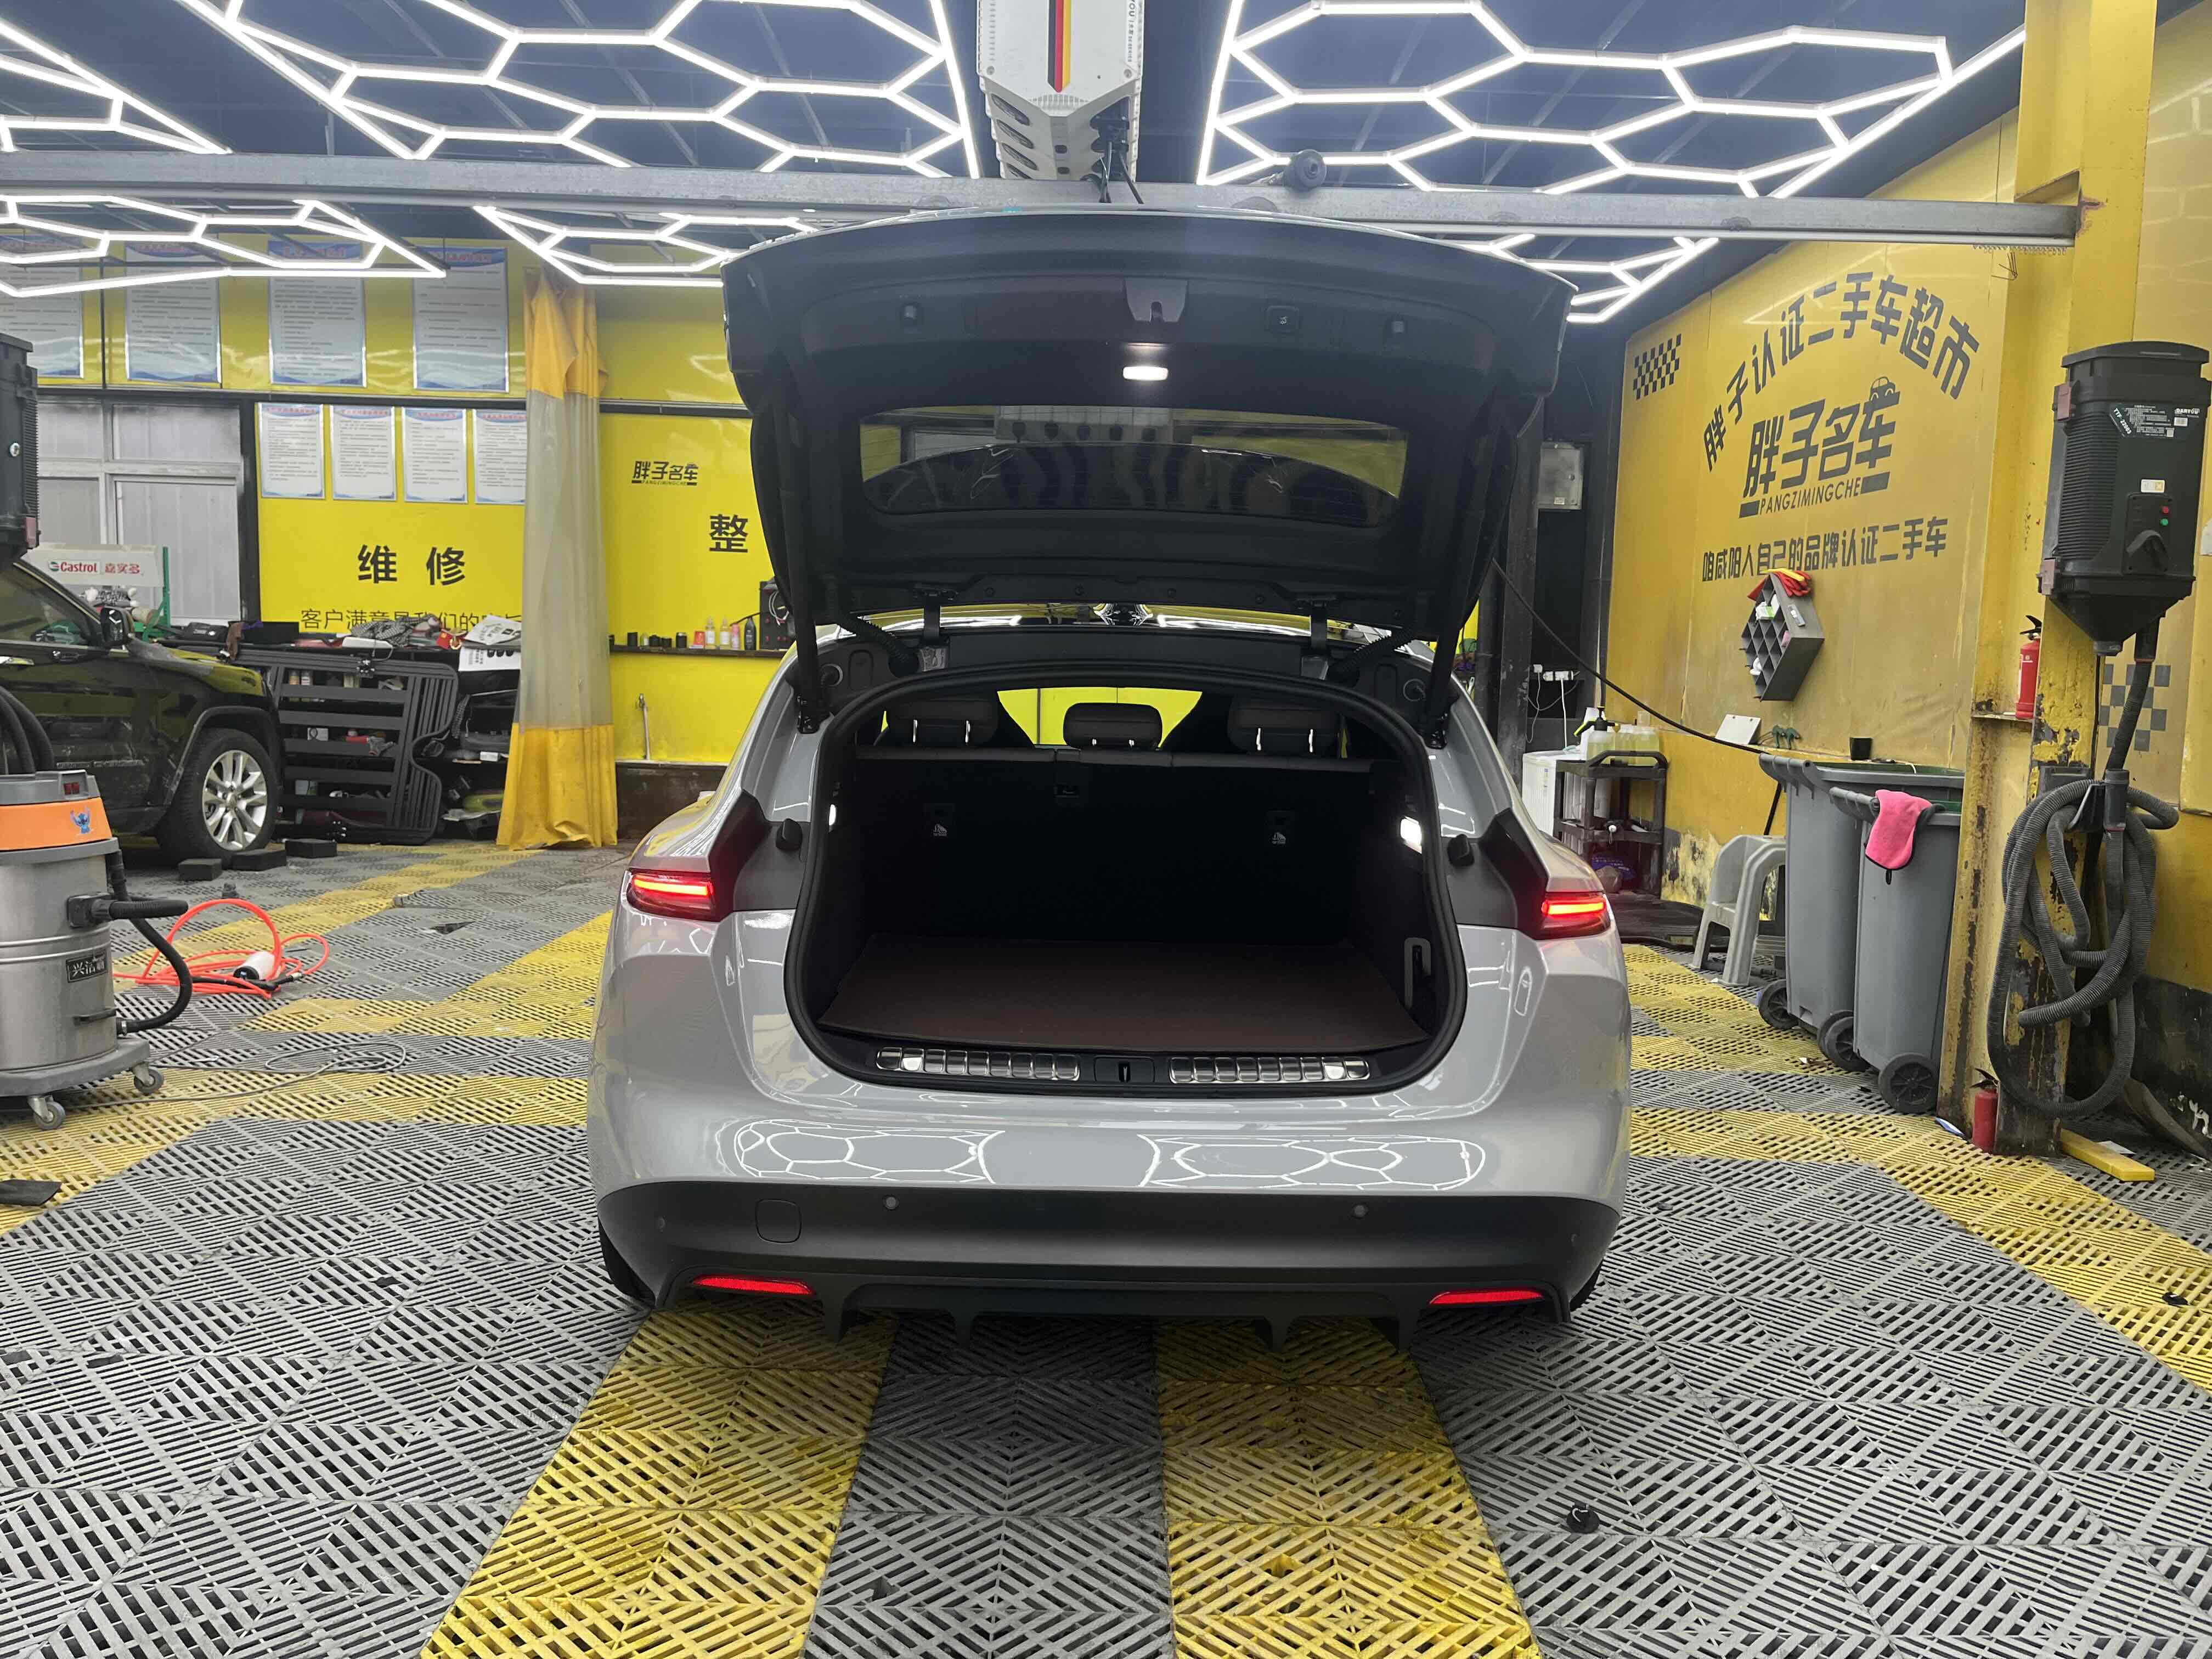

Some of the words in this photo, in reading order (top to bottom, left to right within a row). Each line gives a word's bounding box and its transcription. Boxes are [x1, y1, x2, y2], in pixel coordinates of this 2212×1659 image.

[1703, 272, 1980, 472] 胖子认证二手车超市
[1743, 377, 1900, 498] 胖子名车
[633, 460, 698, 481] 胖子名车
[1759, 476, 1861, 515] PANGZIMINGCHE
[709, 514, 748, 553] 整
[60, 562, 98, 572] Castrol
[358, 544, 465, 586] 维修
